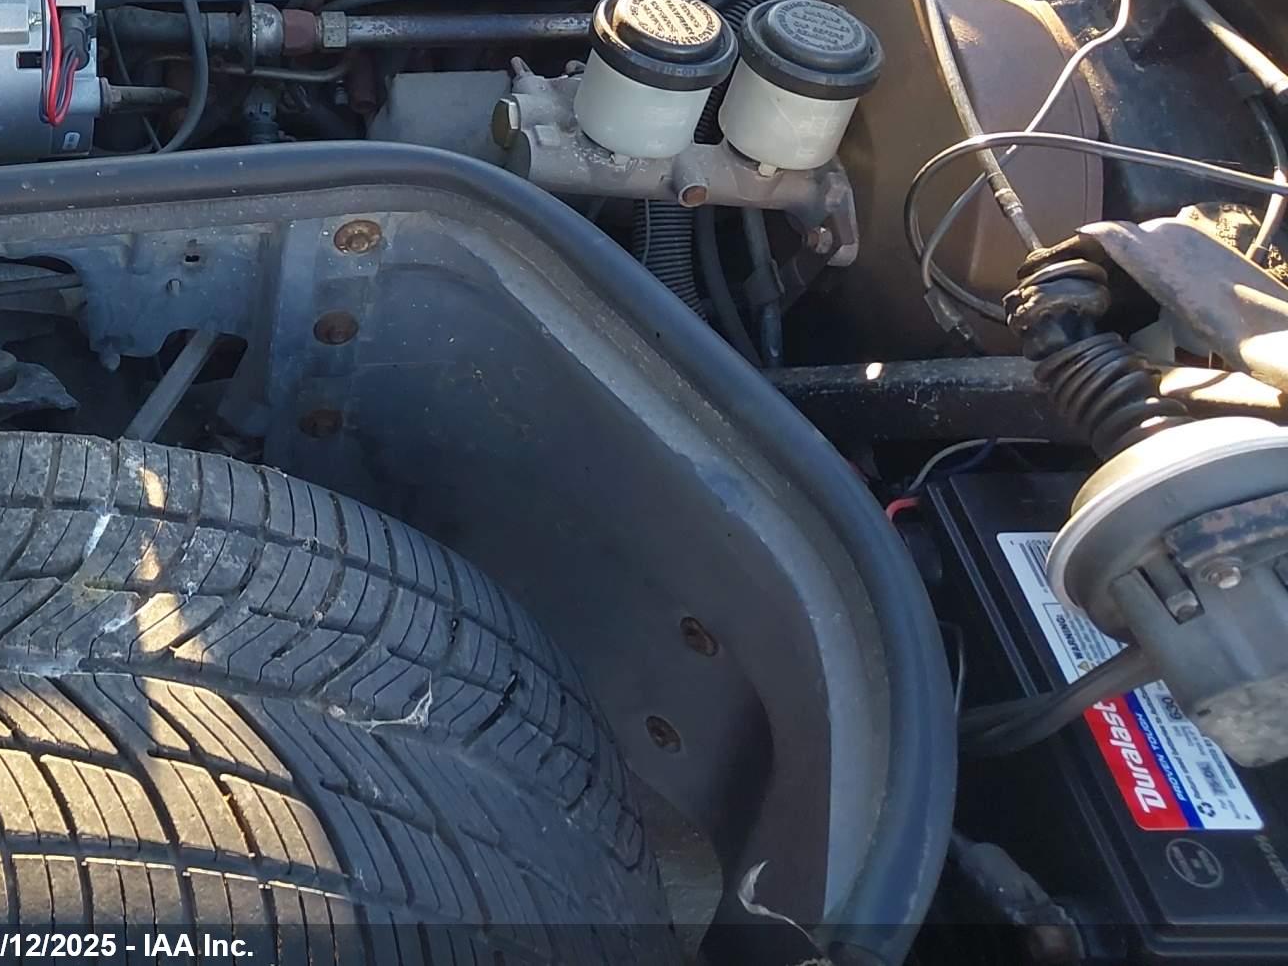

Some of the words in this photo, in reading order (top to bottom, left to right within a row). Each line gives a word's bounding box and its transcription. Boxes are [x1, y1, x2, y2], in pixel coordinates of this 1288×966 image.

[1055, 613, 1083, 660] WARNING:
[1160, 697, 1183, 719] 630
[1136, 713, 1159, 750] TOUGH
[1093, 700, 1167, 813] Duralast
[1156, 755, 1188, 801] PROVEN
